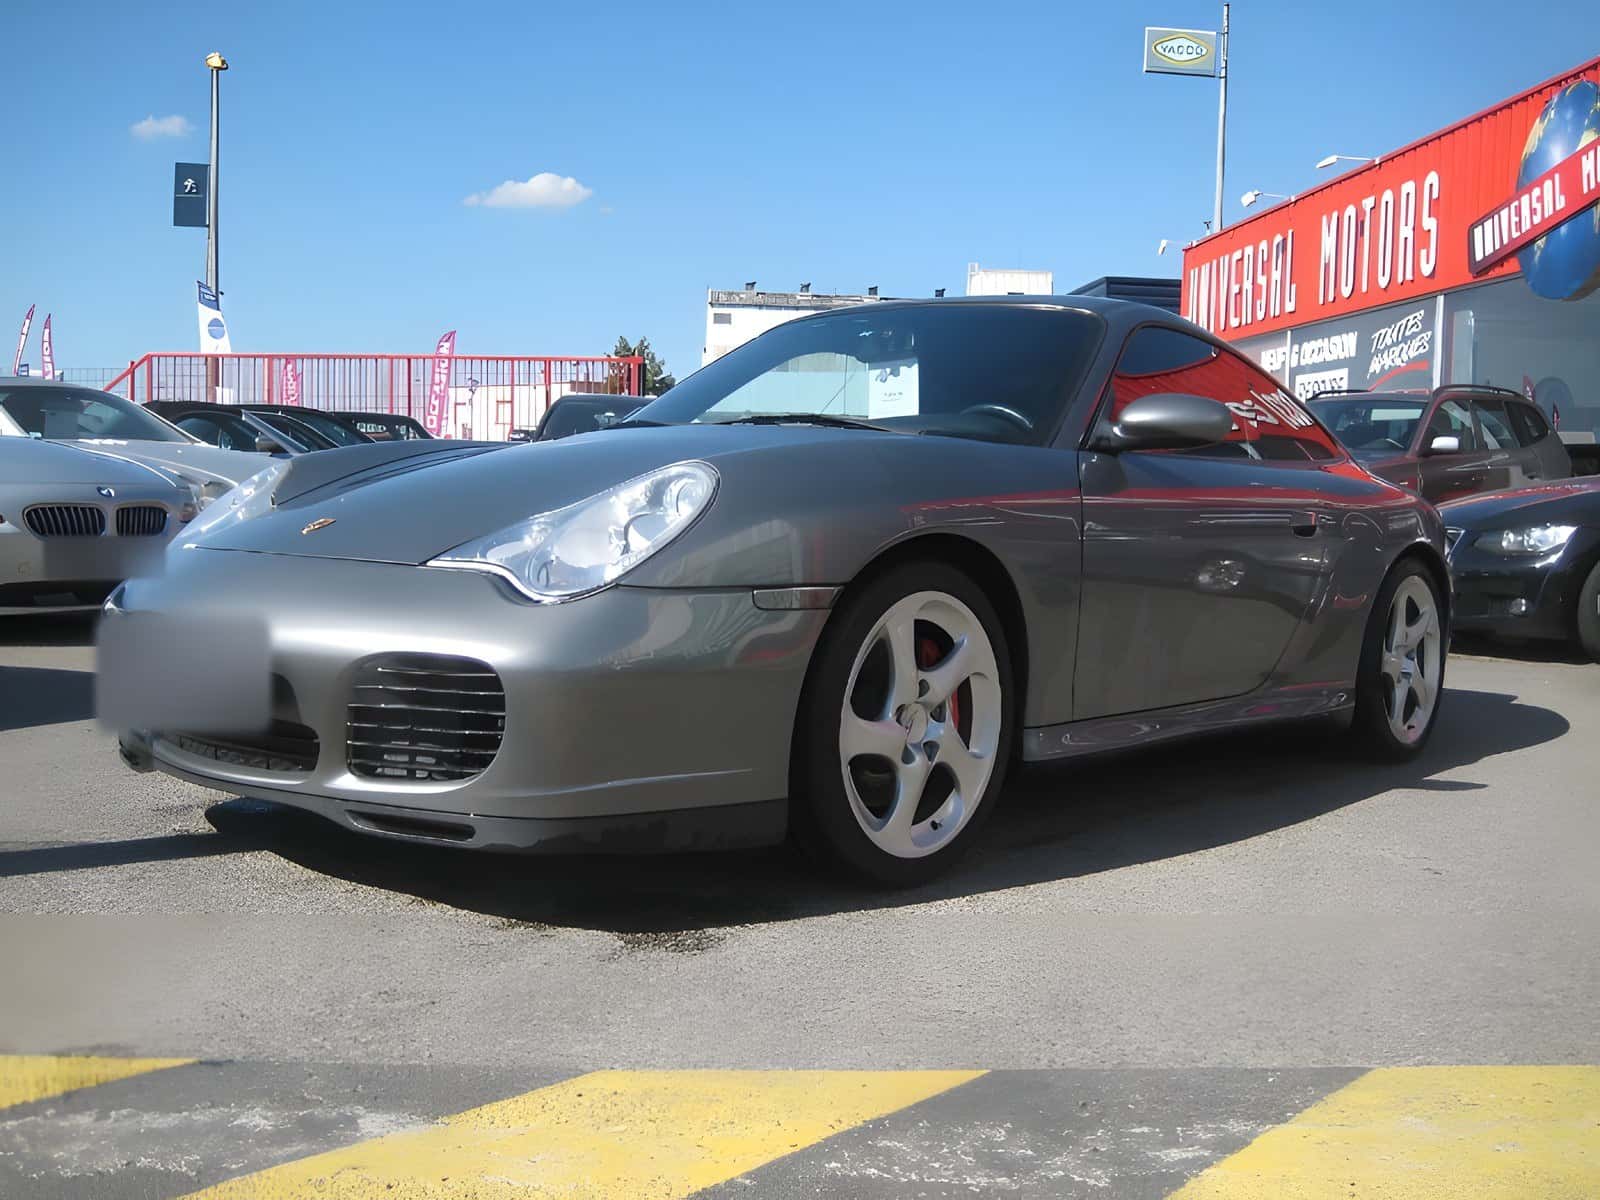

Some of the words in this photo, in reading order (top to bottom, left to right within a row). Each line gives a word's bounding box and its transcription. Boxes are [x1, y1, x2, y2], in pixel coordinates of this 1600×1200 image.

[1474, 172, 1566, 262] UNIVERSAL
[1581, 145, 1600, 195] M
[1186, 229, 1297, 334] UNIVERSAL
[1318, 170, 1439, 305] MOTORS
[1367, 331, 1433, 380] MARQUES
[1371, 309, 1425, 353] TOUTES
